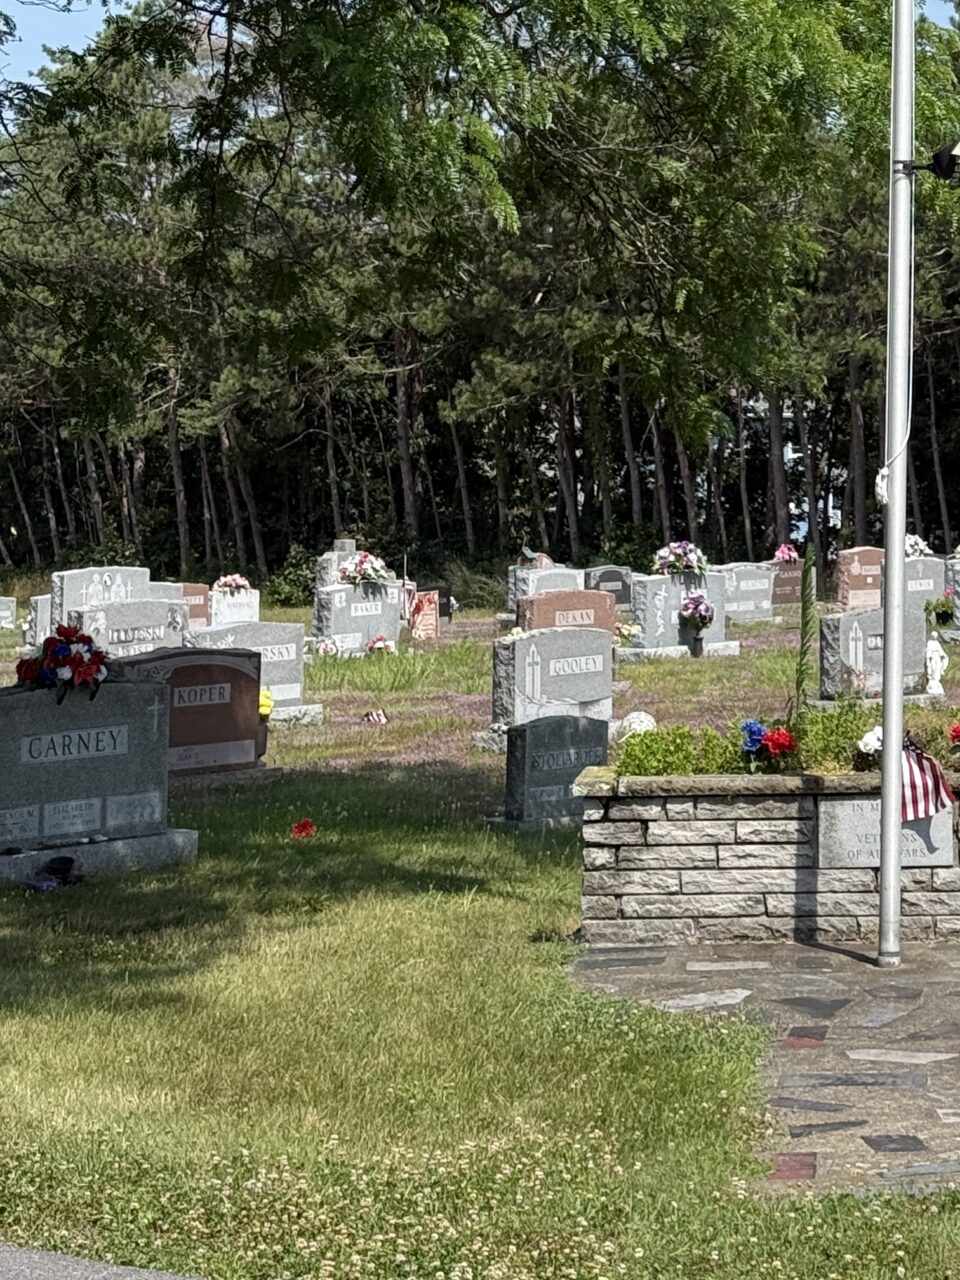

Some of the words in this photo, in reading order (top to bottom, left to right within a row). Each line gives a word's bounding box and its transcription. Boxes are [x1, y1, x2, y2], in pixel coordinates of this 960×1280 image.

[353, 604, 379, 613] BAKER
[558, 610, 592, 624] DEKAN
[553, 656, 597, 676] GOOLEY
[177, 685, 226, 705] KOPER
[28, 729, 122, 760] CARNEY
[852, 803, 864, 814] IN
[856, 832, 917, 844] VETNS
[847, 850, 862, 860] OF
